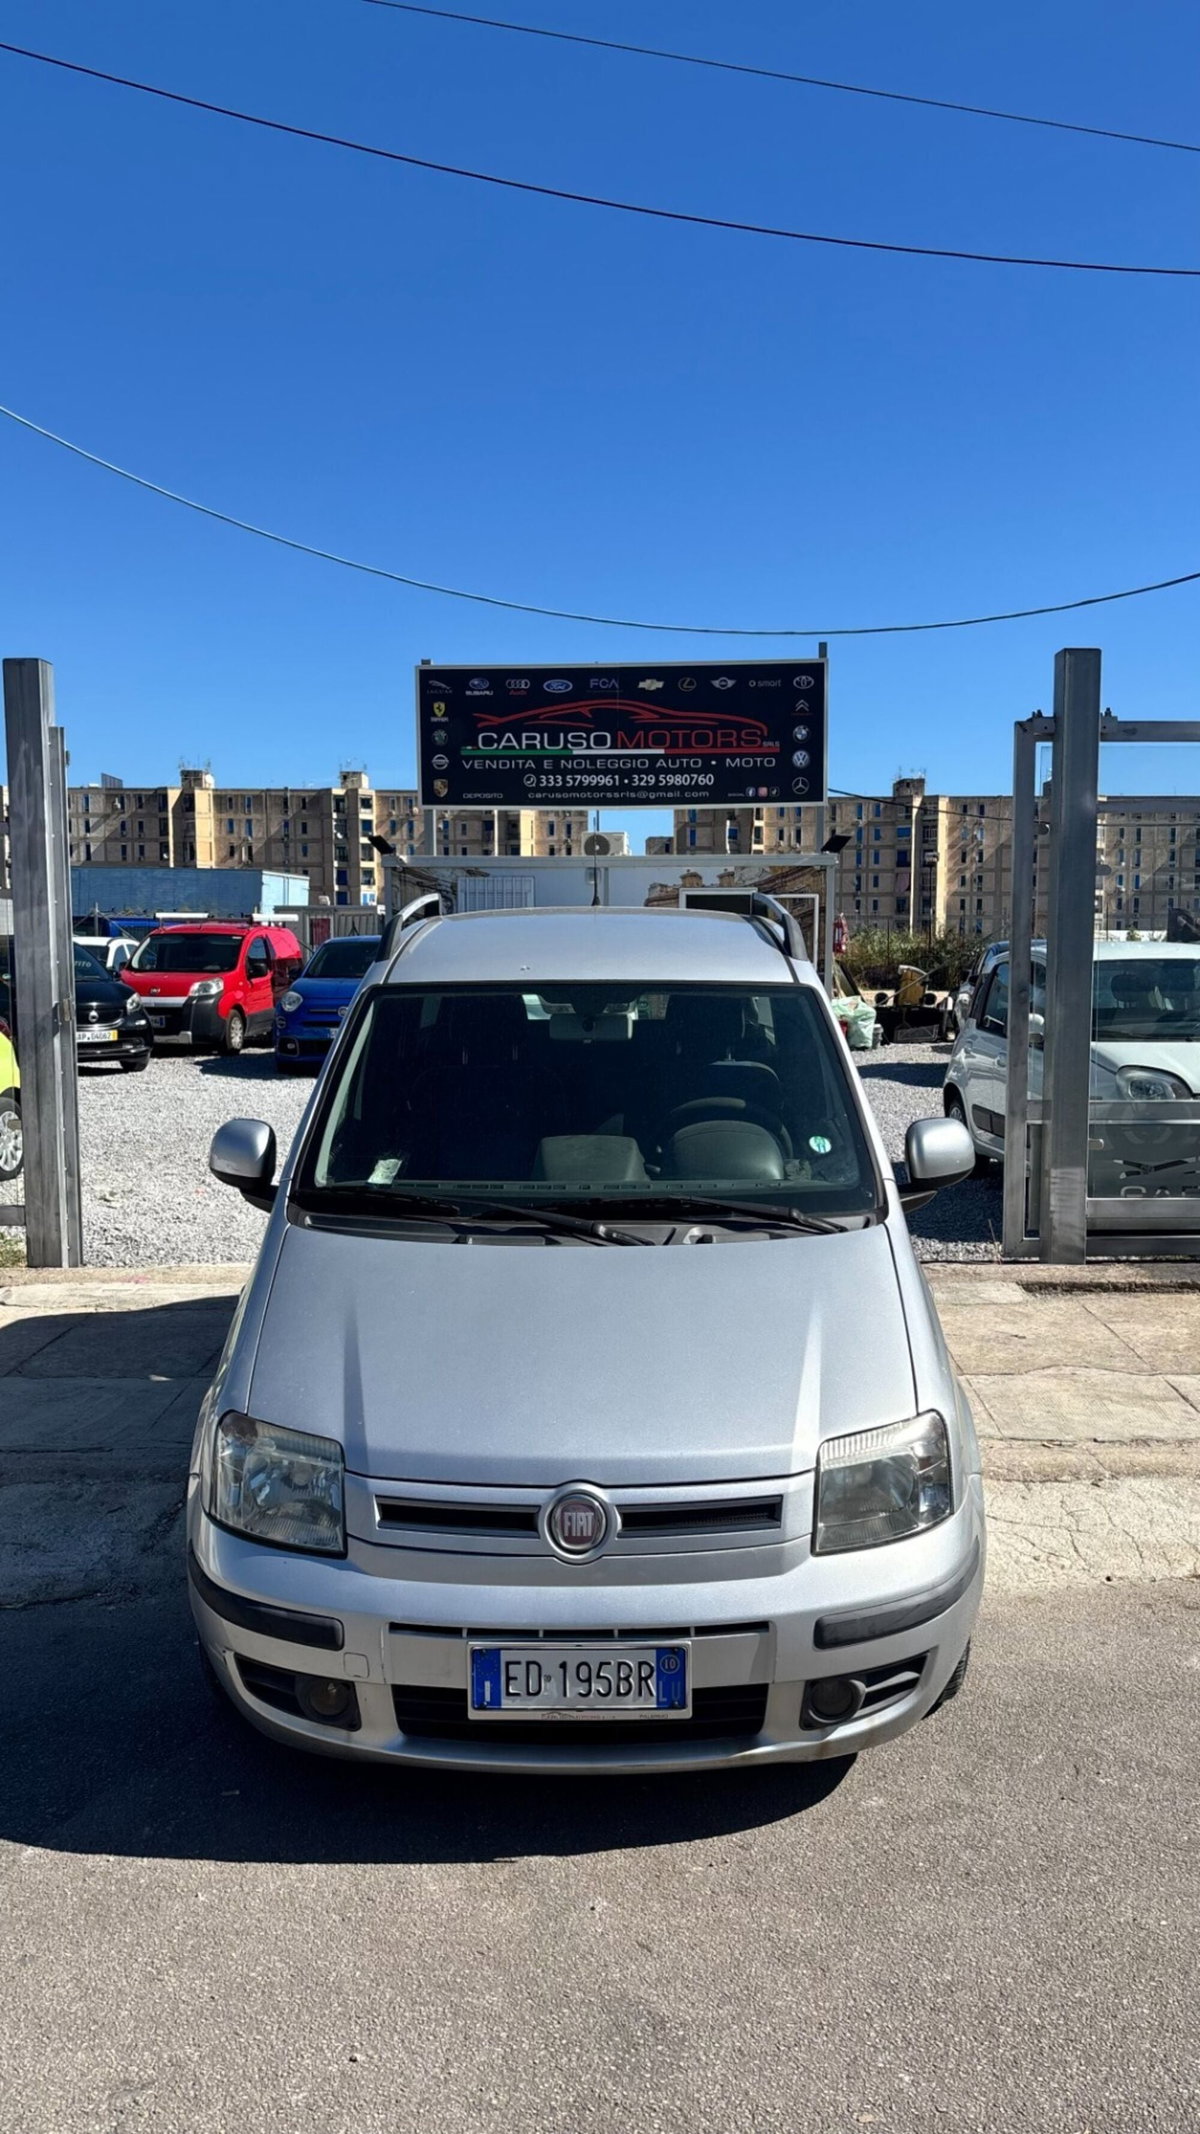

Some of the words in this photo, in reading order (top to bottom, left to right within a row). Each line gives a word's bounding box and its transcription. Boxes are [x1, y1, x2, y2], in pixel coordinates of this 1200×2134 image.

[589, 678, 619, 689] FCA
[757, 679, 782, 687] smart
[477, 731, 612, 750] CARUSO
[616, 730, 763, 749] MOTORS
[462, 759, 536, 769] VENDITA
[543, 759, 554, 769] E
[560, 758, 649, 769] NOLEGGIO
[655, 758, 702, 769] AUTO
[725, 757, 776, 768] MOTO
[538, 775, 563, 786] 333
[565, 775, 620, 787] 5799961
[631, 774, 656, 786] 329
[658, 774, 715, 786] 5980760
[527, 789, 710, 799] carusomotorssrls@gmail.com
[563, 1511, 594, 1537] FIAT
[664, 1656, 676, 1669] 10
[504, 1660, 543, 1698] ED
[558, 1659, 657, 1699] 195BR
[658, 1680, 682, 1702] LU
